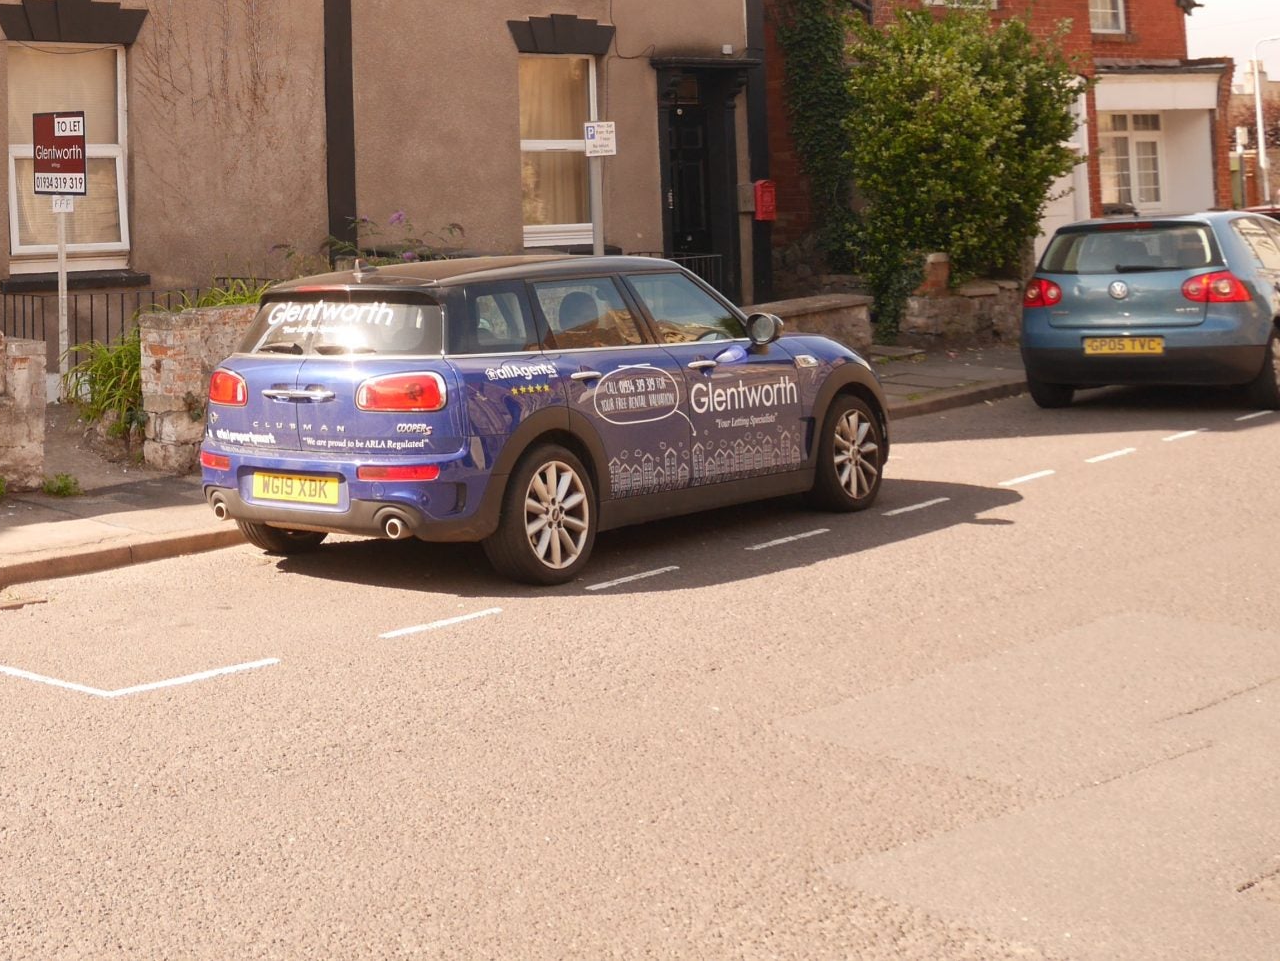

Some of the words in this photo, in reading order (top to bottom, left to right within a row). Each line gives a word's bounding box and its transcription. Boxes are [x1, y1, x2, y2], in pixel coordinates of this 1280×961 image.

[57, 121, 67, 132] TO
[69, 120, 80, 132] LET
[35, 145, 82, 160] Glentworth
[36, 176, 53, 189] 01934
[54, 177, 67, 189] 319
[69, 177, 83, 190] 319
[268, 299, 394, 326] Glentworth
[1090, 339, 1125, 351] GP05
[1130, 339, 1156, 351] TVC
[497, 363, 556, 380] allAgents
[605, 381, 618, 395] CALL
[655, 376, 666, 389] FOR
[690, 375, 798, 414] Glentworth
[600, 397, 614, 412] YOUR
[615, 397, 627, 410] FREE
[628, 394, 647, 409] RENTAL
[648, 393, 675, 407] VALUATION
[252, 421, 345, 432] CLUBMAN
[731, 417, 749, 428] Letting
[327, 438, 346, 448] proud
[347, 438, 354, 447] to
[356, 438, 364, 448] be
[365, 439, 385, 448] ARLA
[262, 475, 294, 495] WG19
